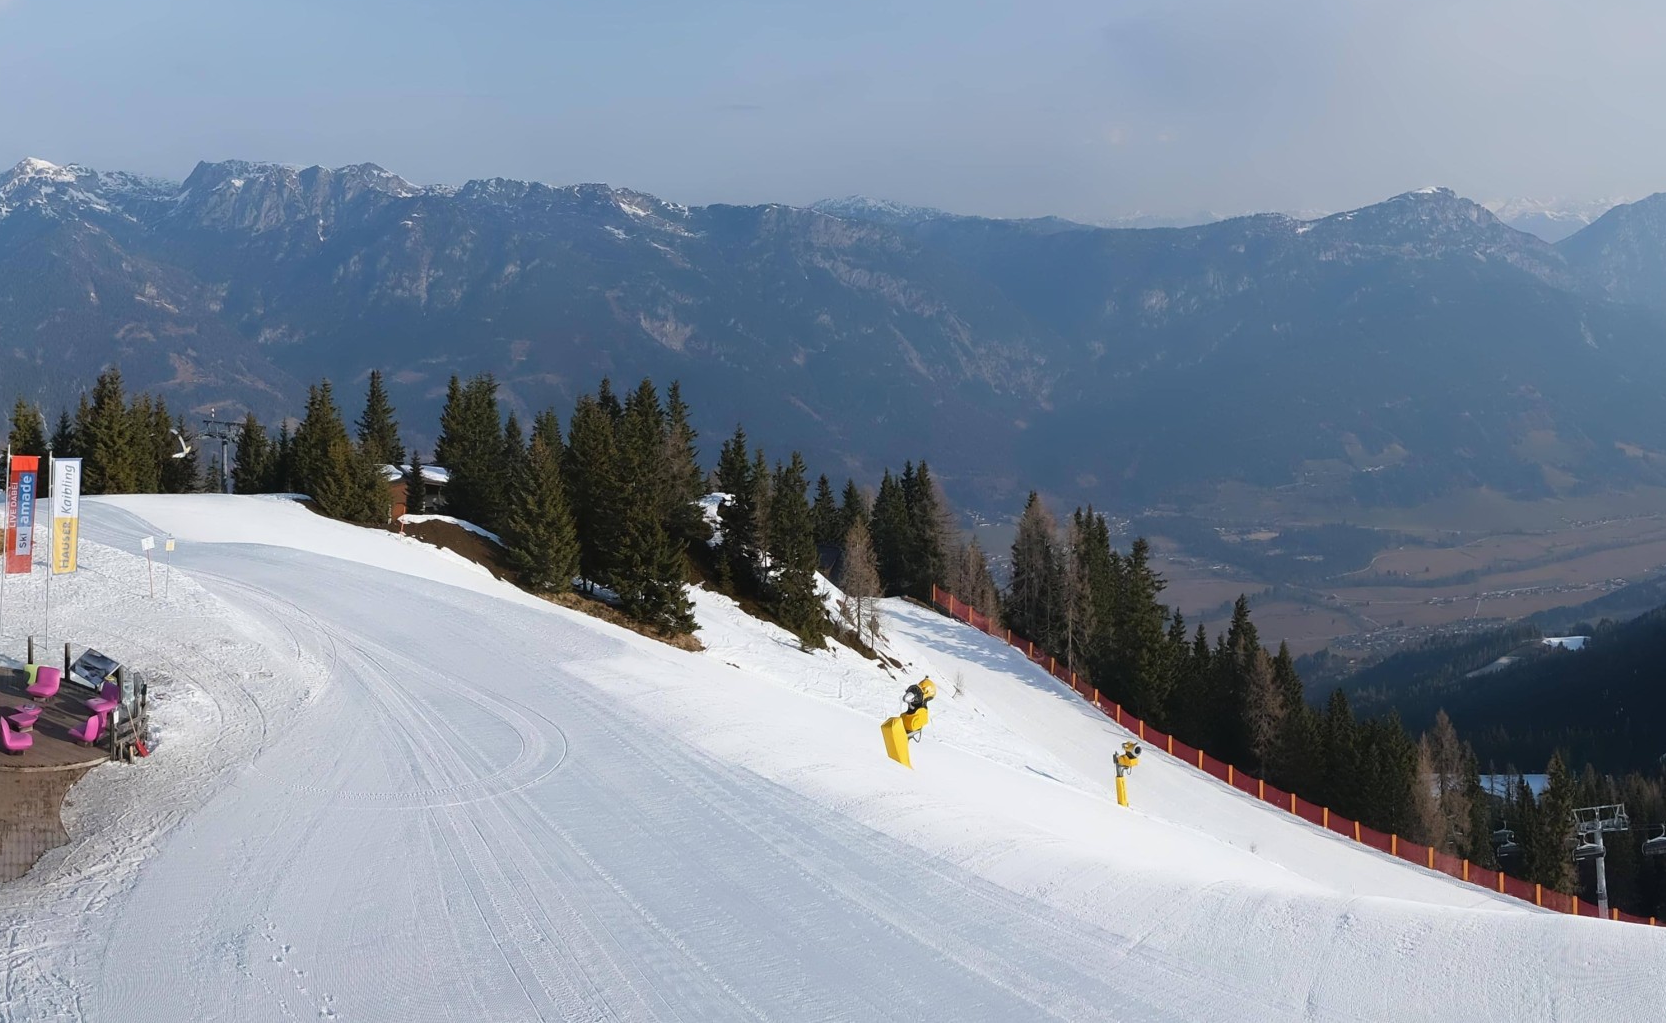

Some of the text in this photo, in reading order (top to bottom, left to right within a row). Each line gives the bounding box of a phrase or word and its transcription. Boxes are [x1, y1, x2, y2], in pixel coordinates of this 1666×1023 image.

[9, 508, 17, 528] LIVE
[60, 464, 75, 569] HAUSER Kaibling
[19, 533, 27, 548] Ski
